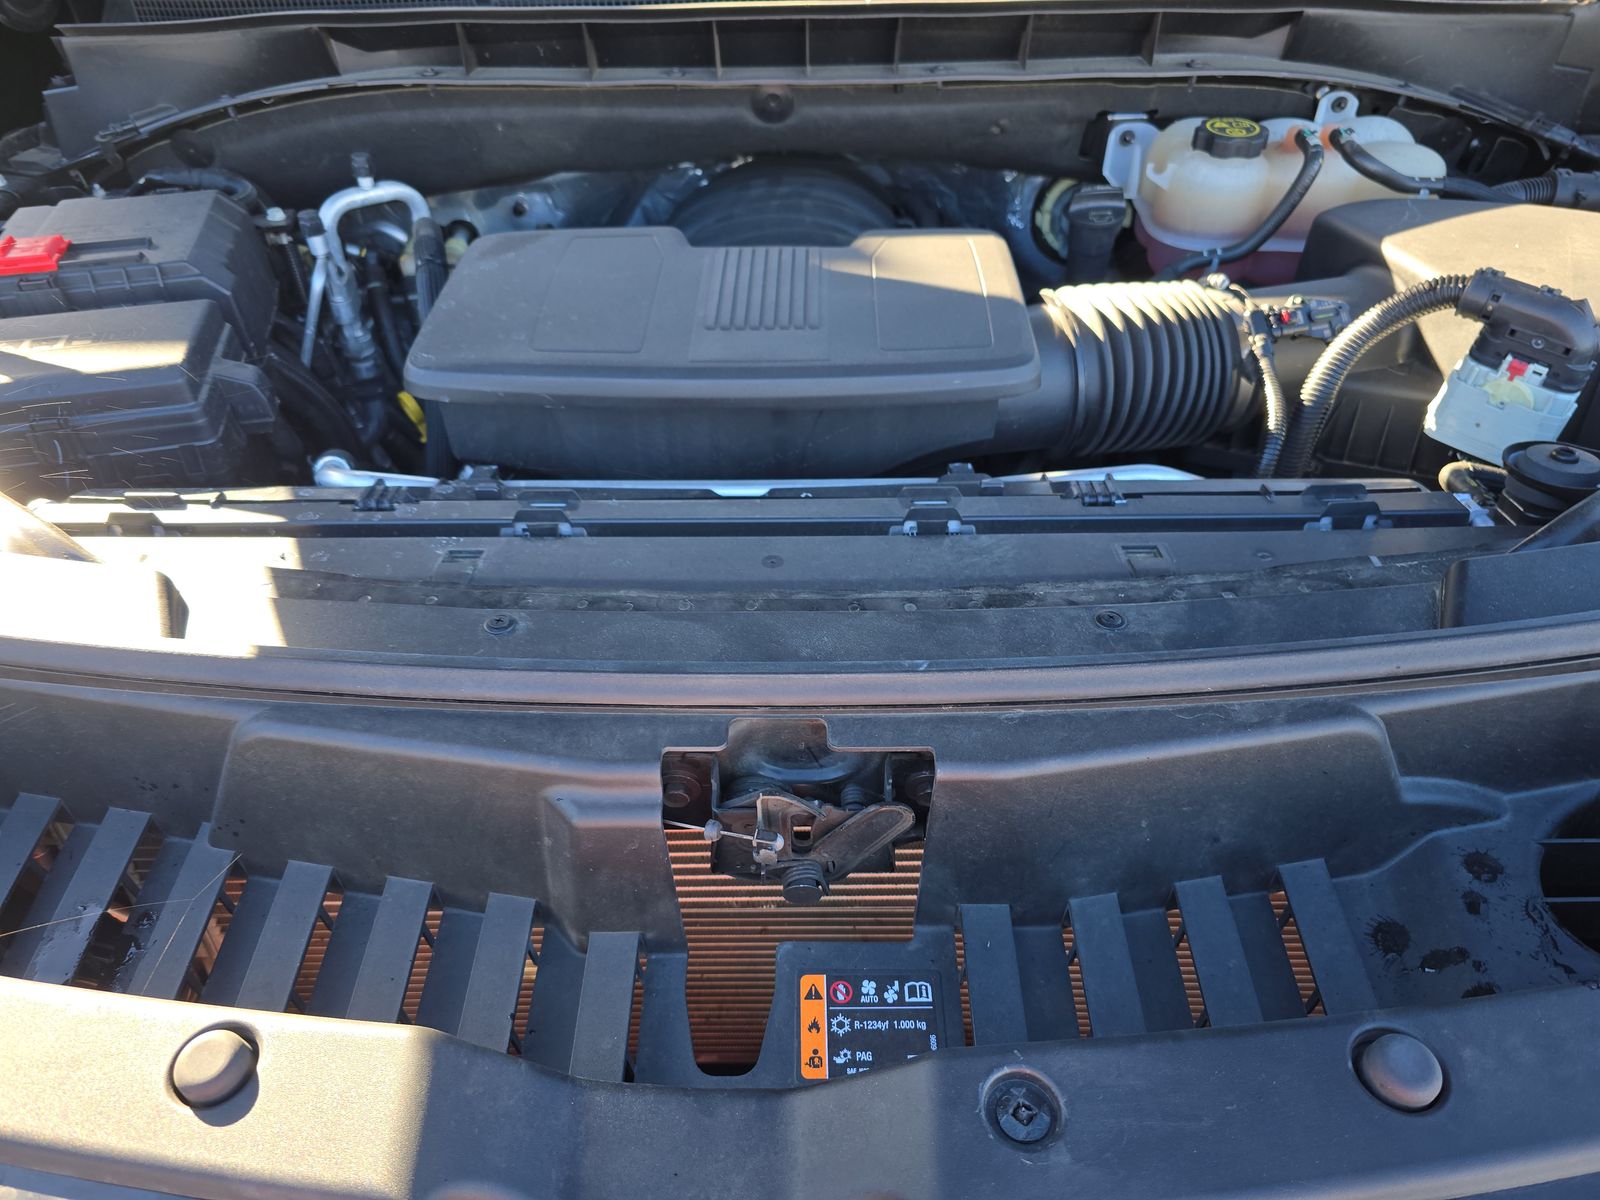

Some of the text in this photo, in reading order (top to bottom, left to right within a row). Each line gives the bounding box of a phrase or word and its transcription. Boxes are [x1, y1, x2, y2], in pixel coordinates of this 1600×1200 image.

[860, 995, 879, 1003] AUTO
[854, 1019, 927, 1031] R-1234yf 1.000 kg
[856, 1051, 872, 1062] PAG
